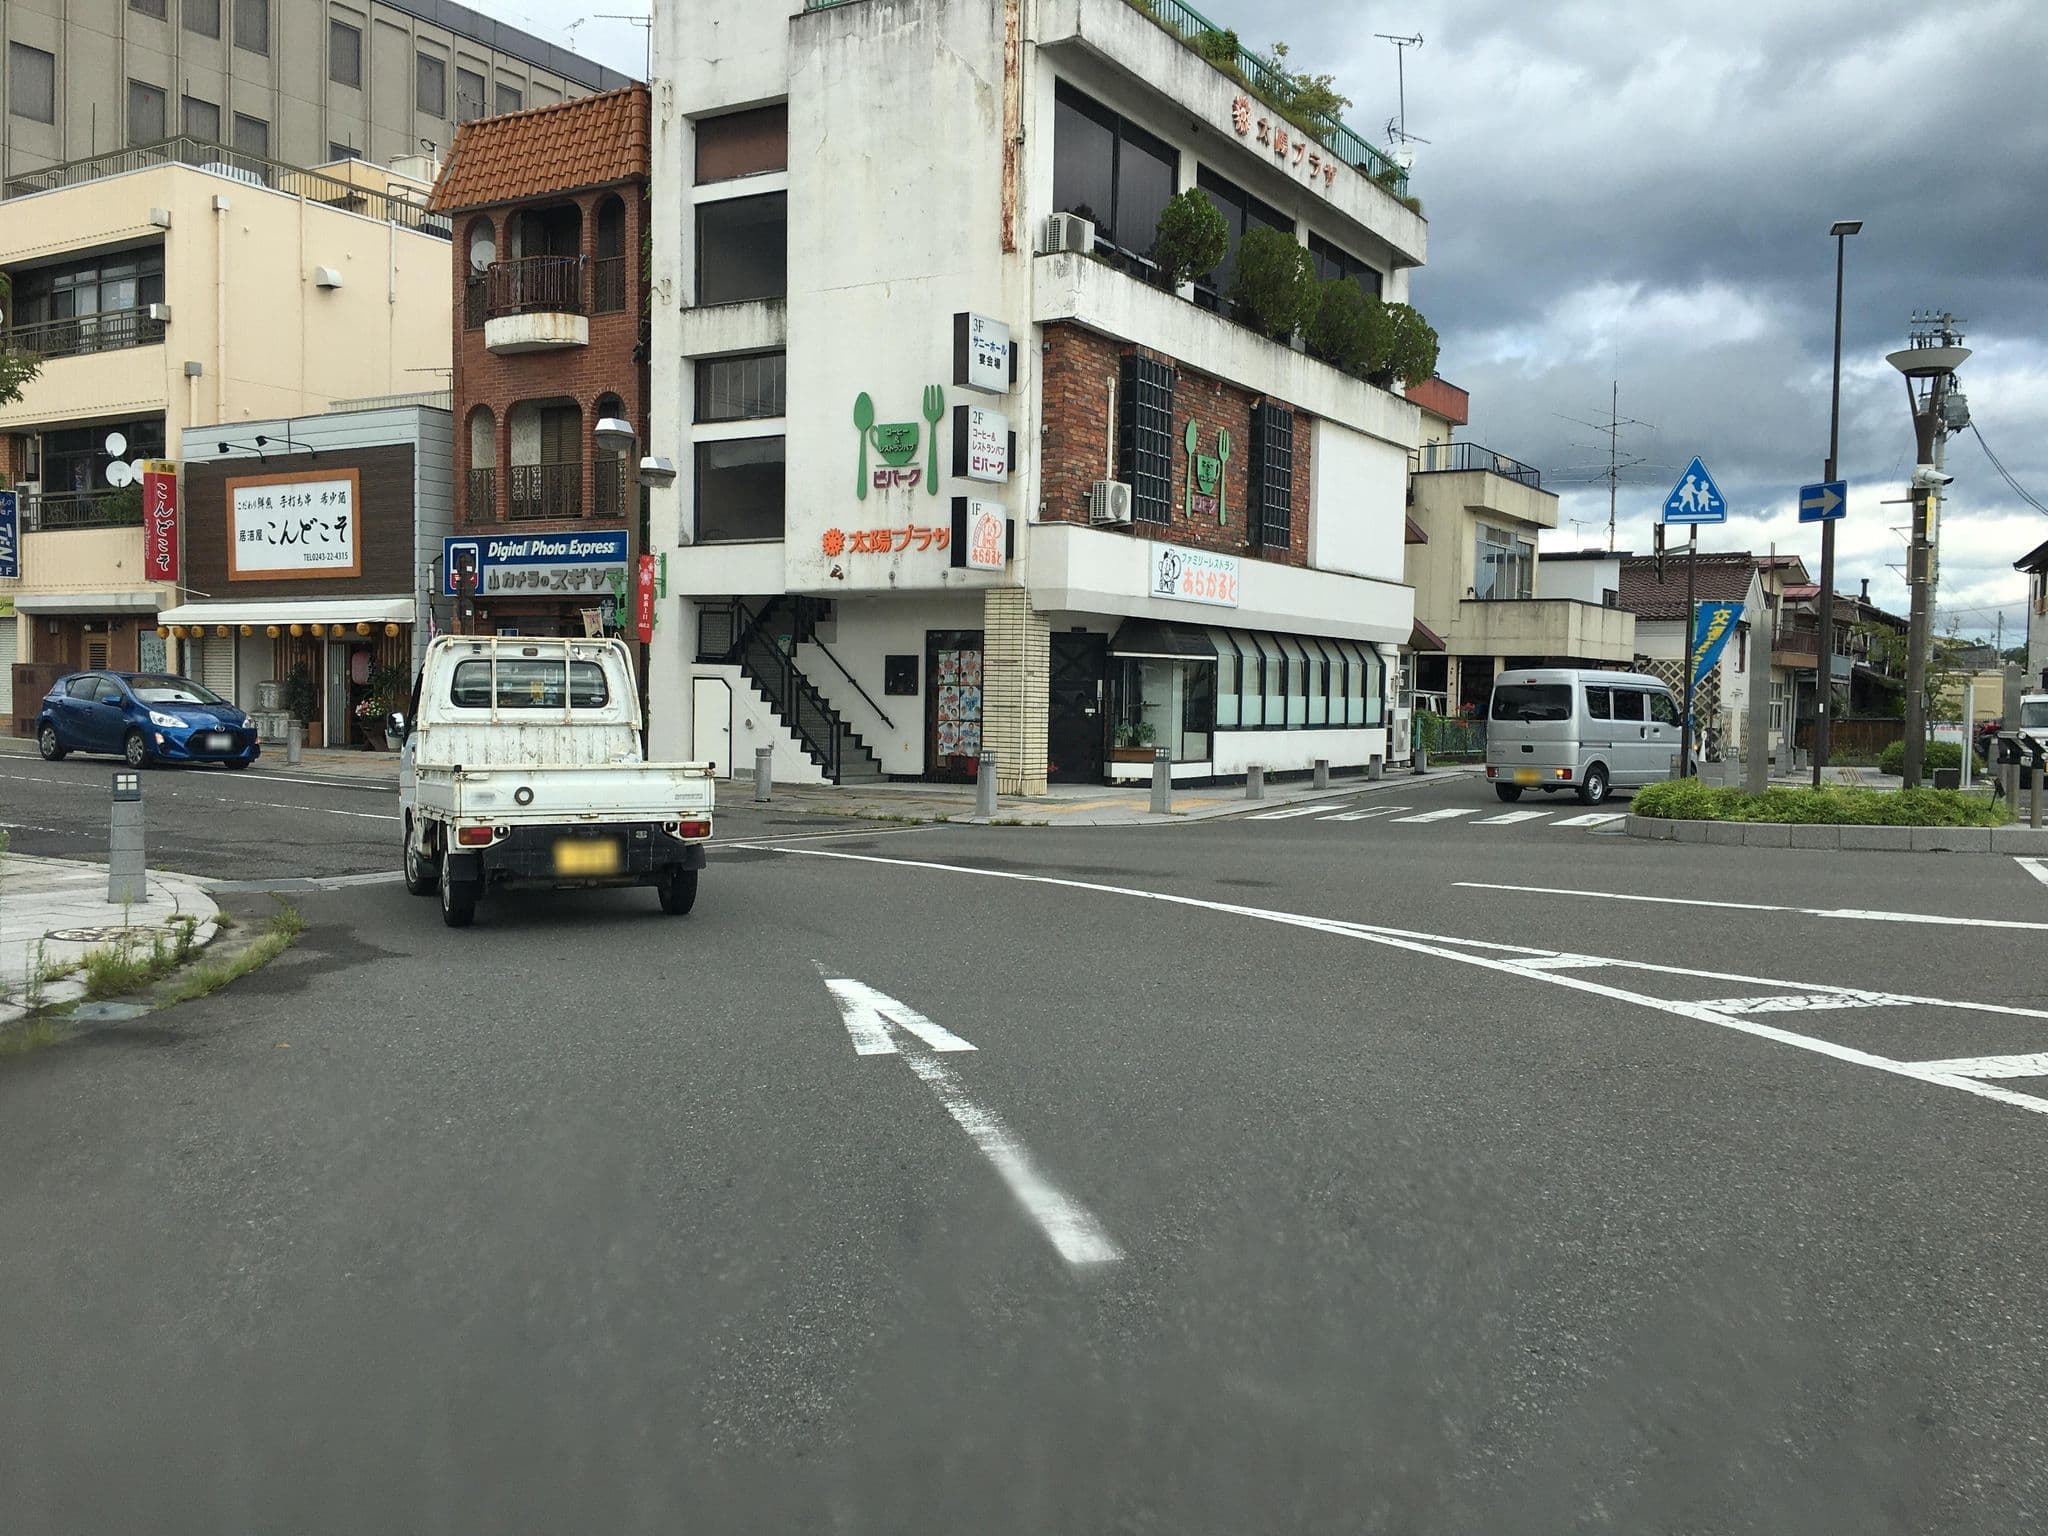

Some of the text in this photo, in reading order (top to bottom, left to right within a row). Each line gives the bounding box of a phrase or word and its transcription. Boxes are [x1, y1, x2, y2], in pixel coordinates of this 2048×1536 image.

[973, 318, 984, 333] 3F
[973, 336, 1007, 356] サニーホール
[973, 411, 984, 425] 2F
[972, 503, 981, 516] 1F
[153, 482, 174, 572] こんどこそ
[267, 515, 348, 545] こんどこそ
[488, 539, 616, 561] Digital Photo Express
[1181, 553, 1235, 571] ファミリーレストラン
[1183, 567, 1236, 602] あらかると
